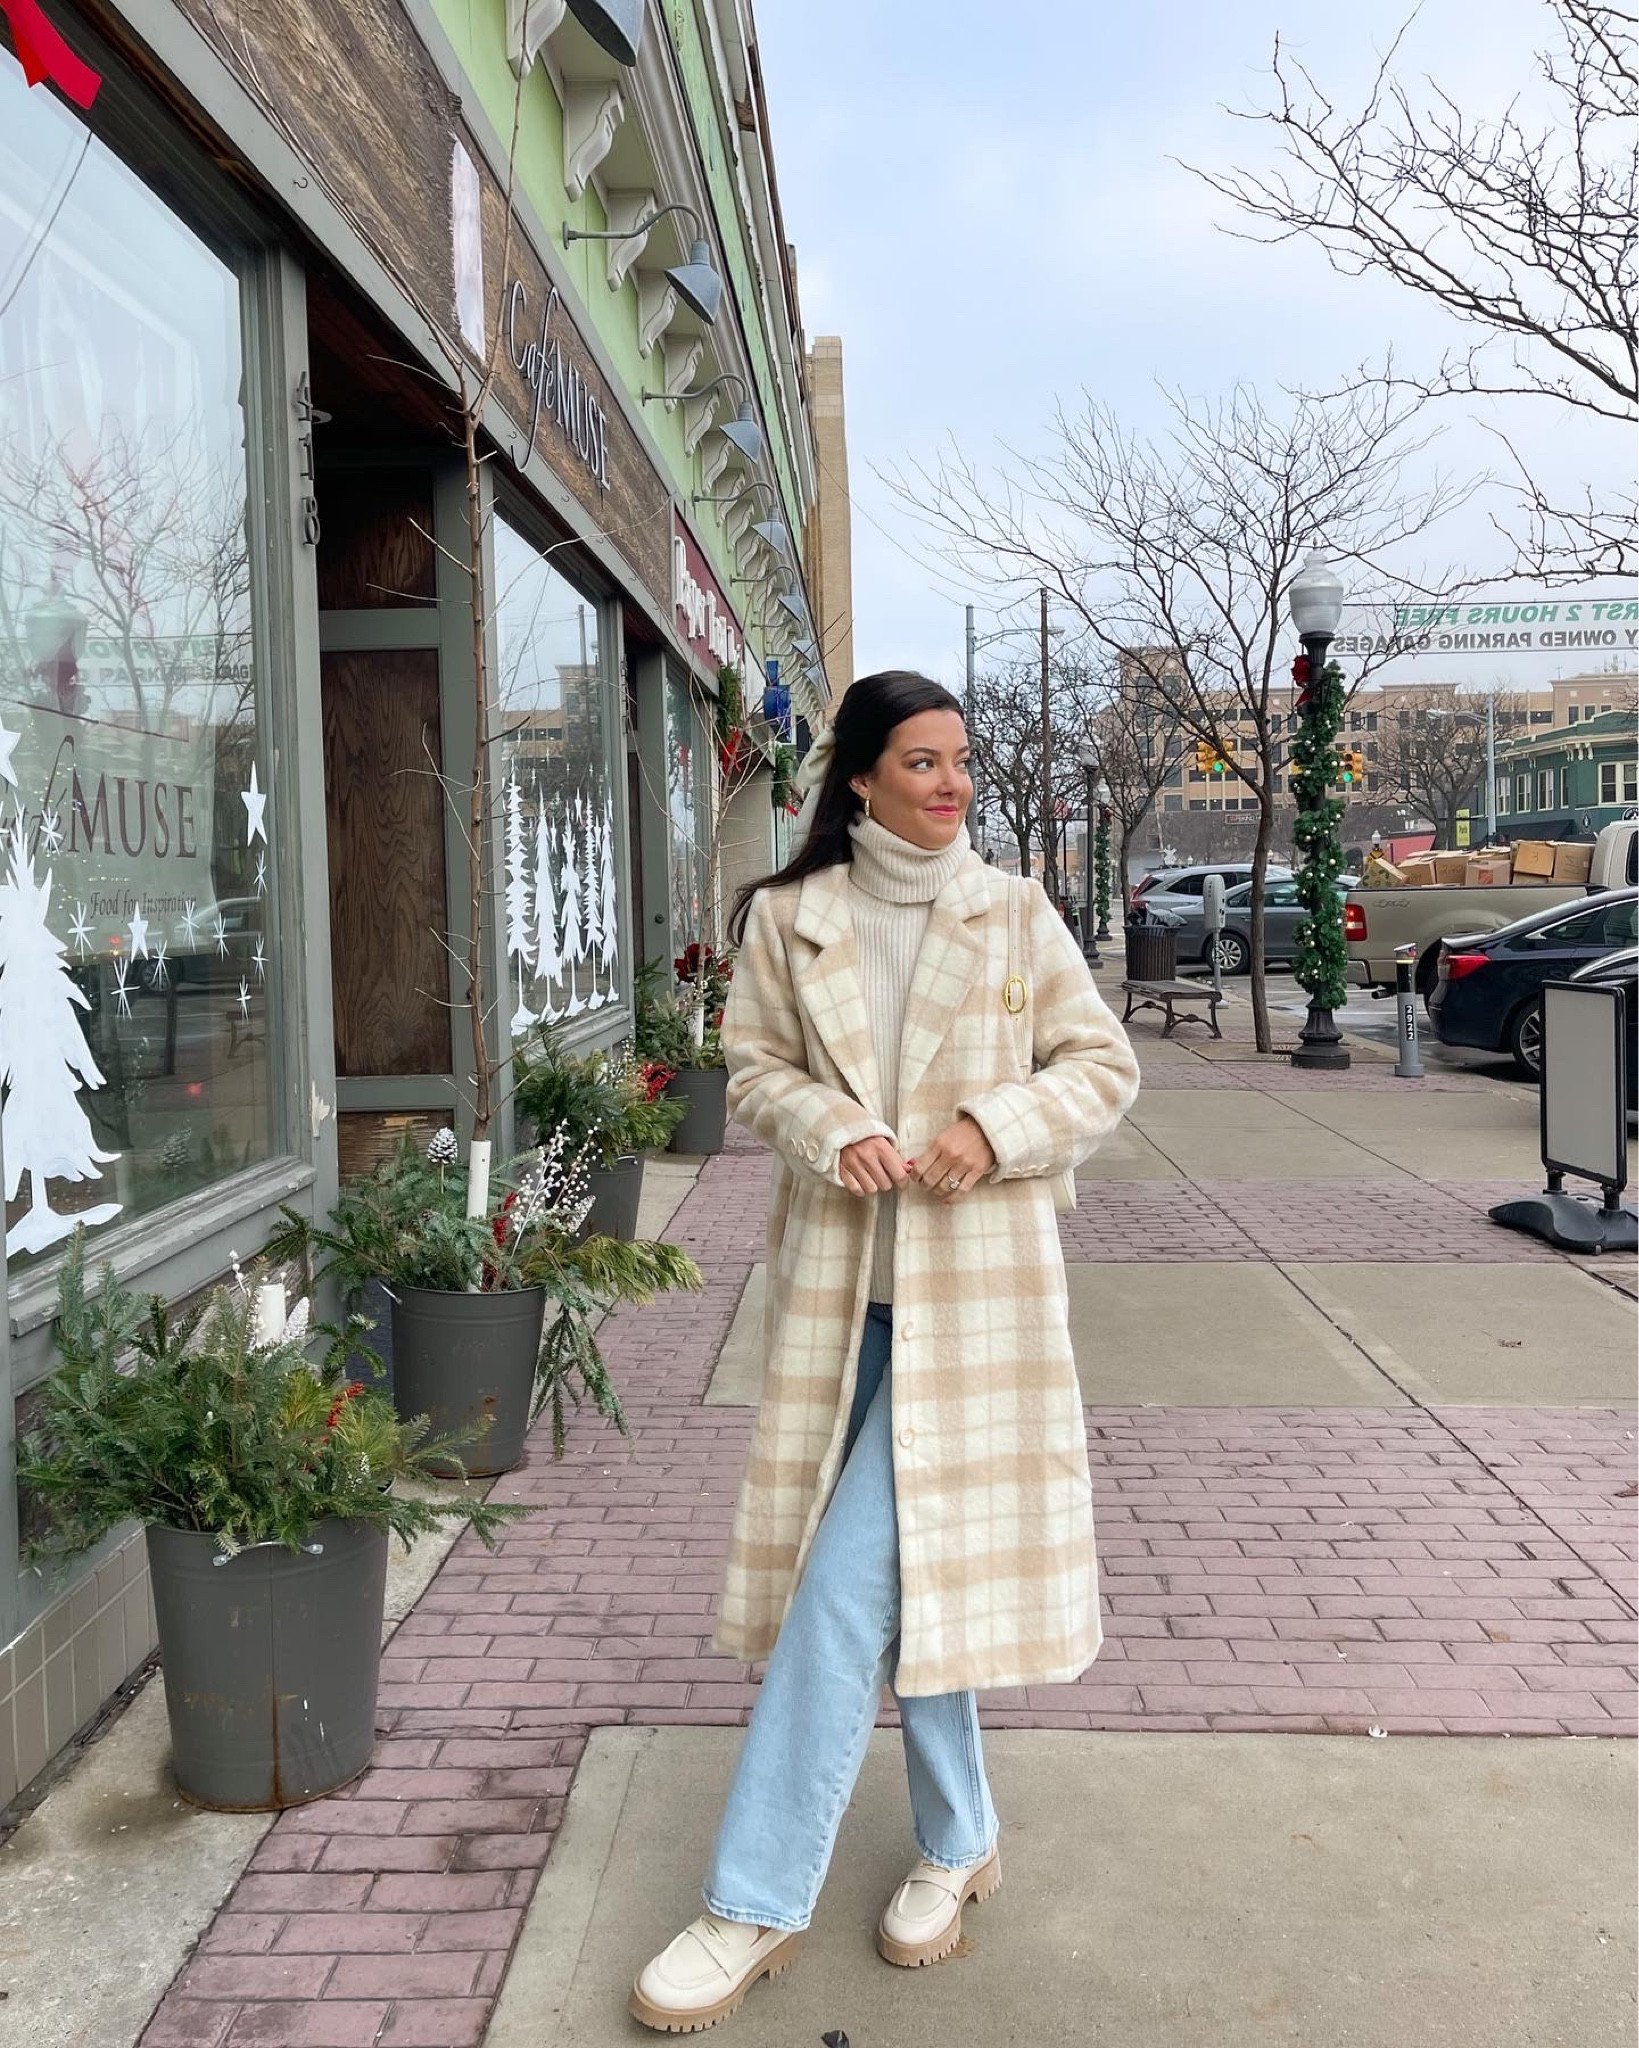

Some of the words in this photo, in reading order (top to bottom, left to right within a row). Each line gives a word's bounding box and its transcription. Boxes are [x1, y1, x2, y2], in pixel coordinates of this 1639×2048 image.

[298, 371, 320, 546] 418
[555, 337, 610, 491] MUSE
[68, 767, 197, 858] MUSE
[90, 889, 121, 919] Food
[1405, 1004, 1415, 1040] 2922
